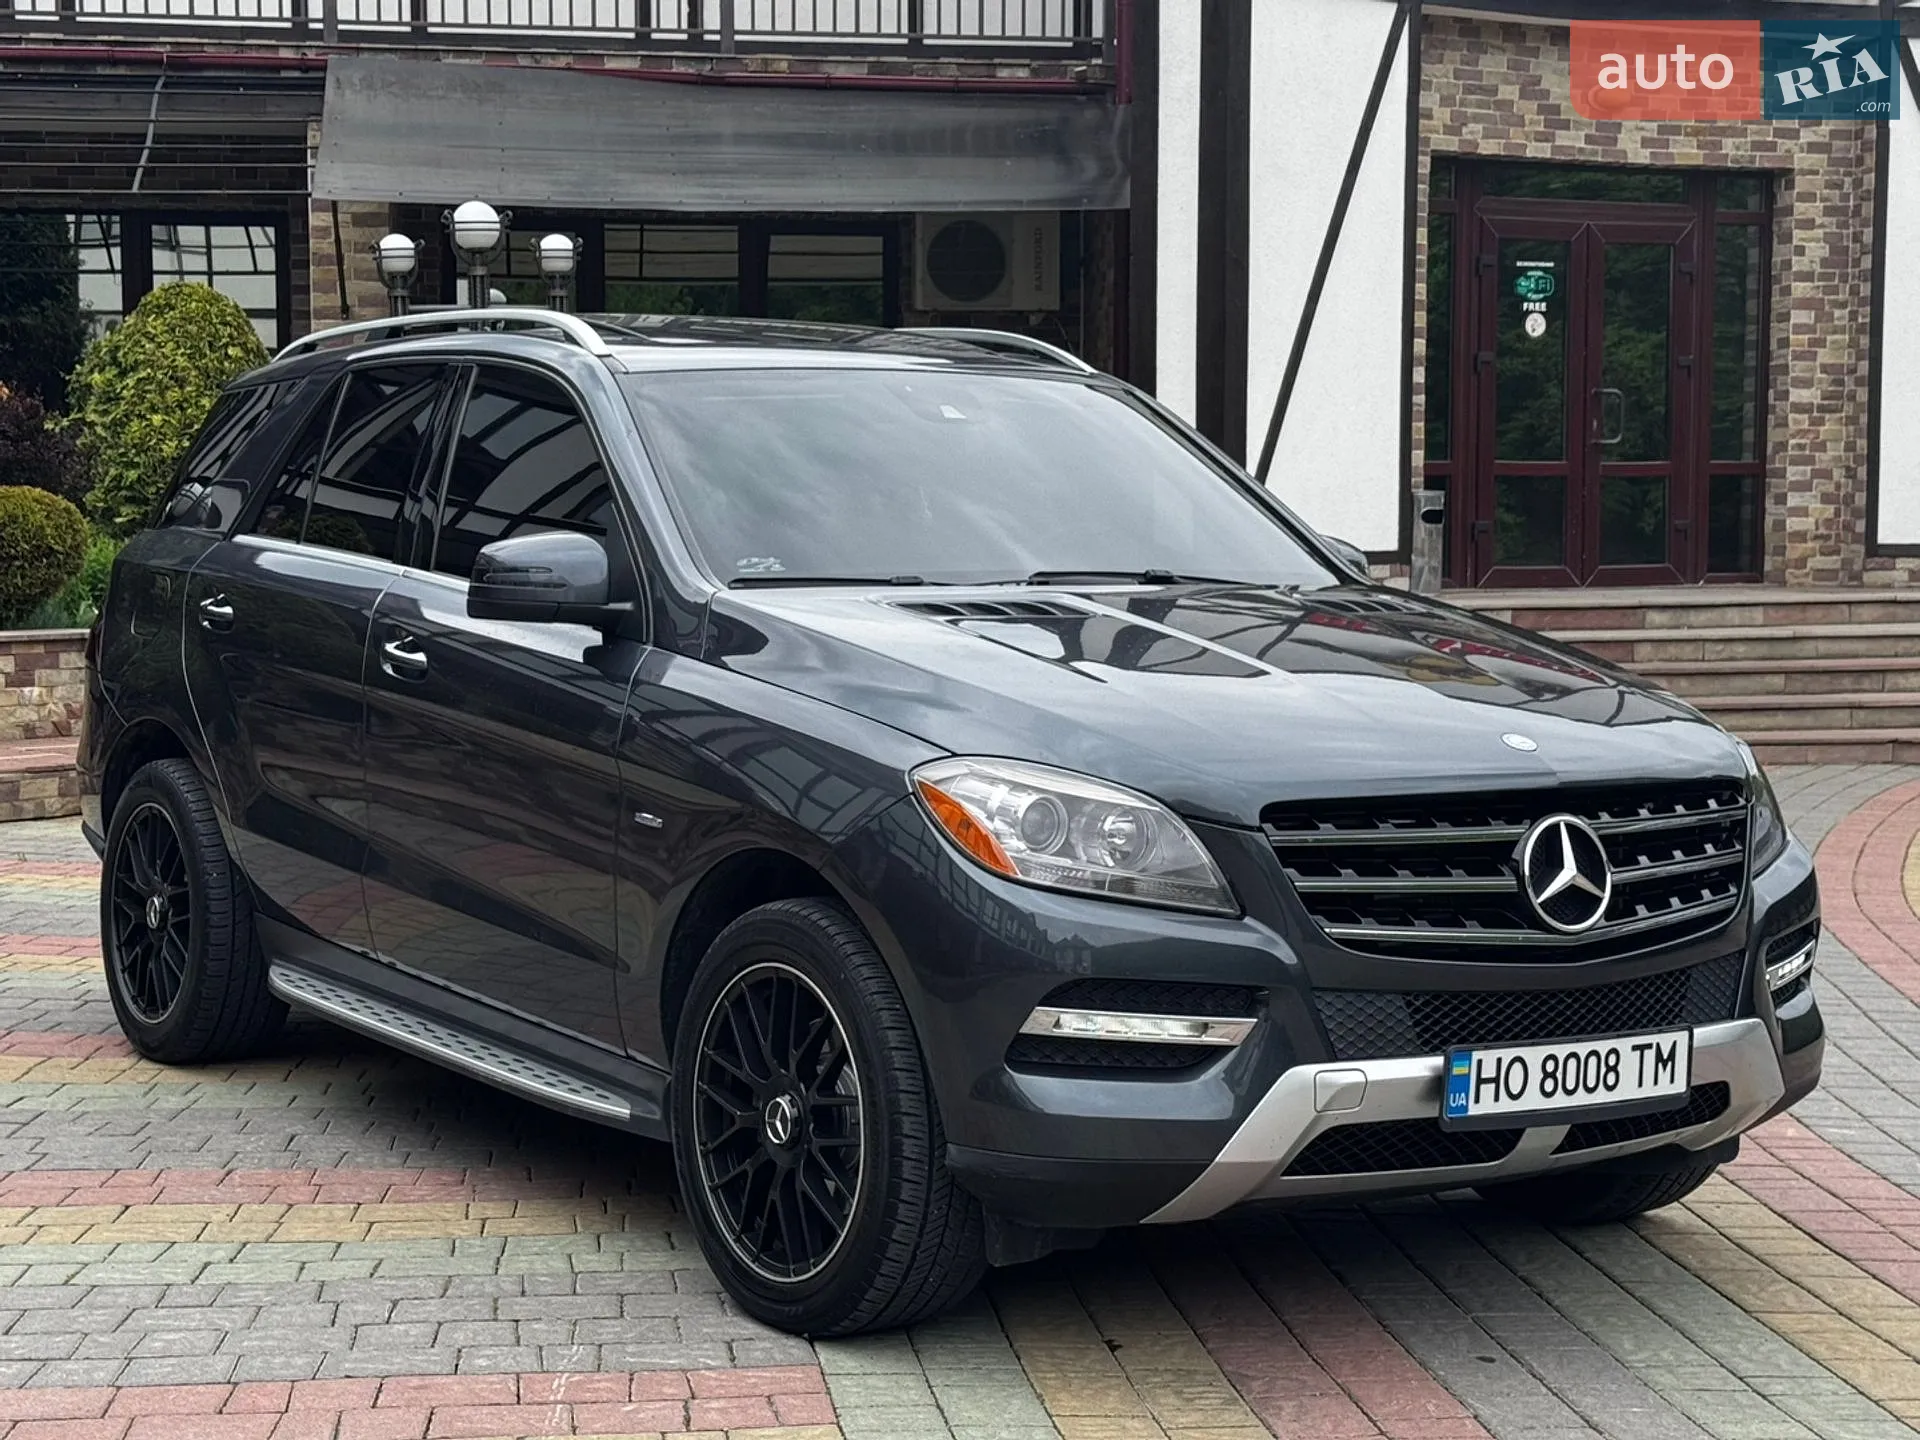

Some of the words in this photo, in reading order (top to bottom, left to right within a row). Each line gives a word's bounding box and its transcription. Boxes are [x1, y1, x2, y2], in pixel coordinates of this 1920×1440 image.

[1523, 302, 1547, 312] FREE
[1473, 1056, 1529, 1105] HO
[1539, 1047, 1621, 1099] 8008
[1631, 1039, 1678, 1088] TM
[1450, 1094, 1467, 1106] UA
